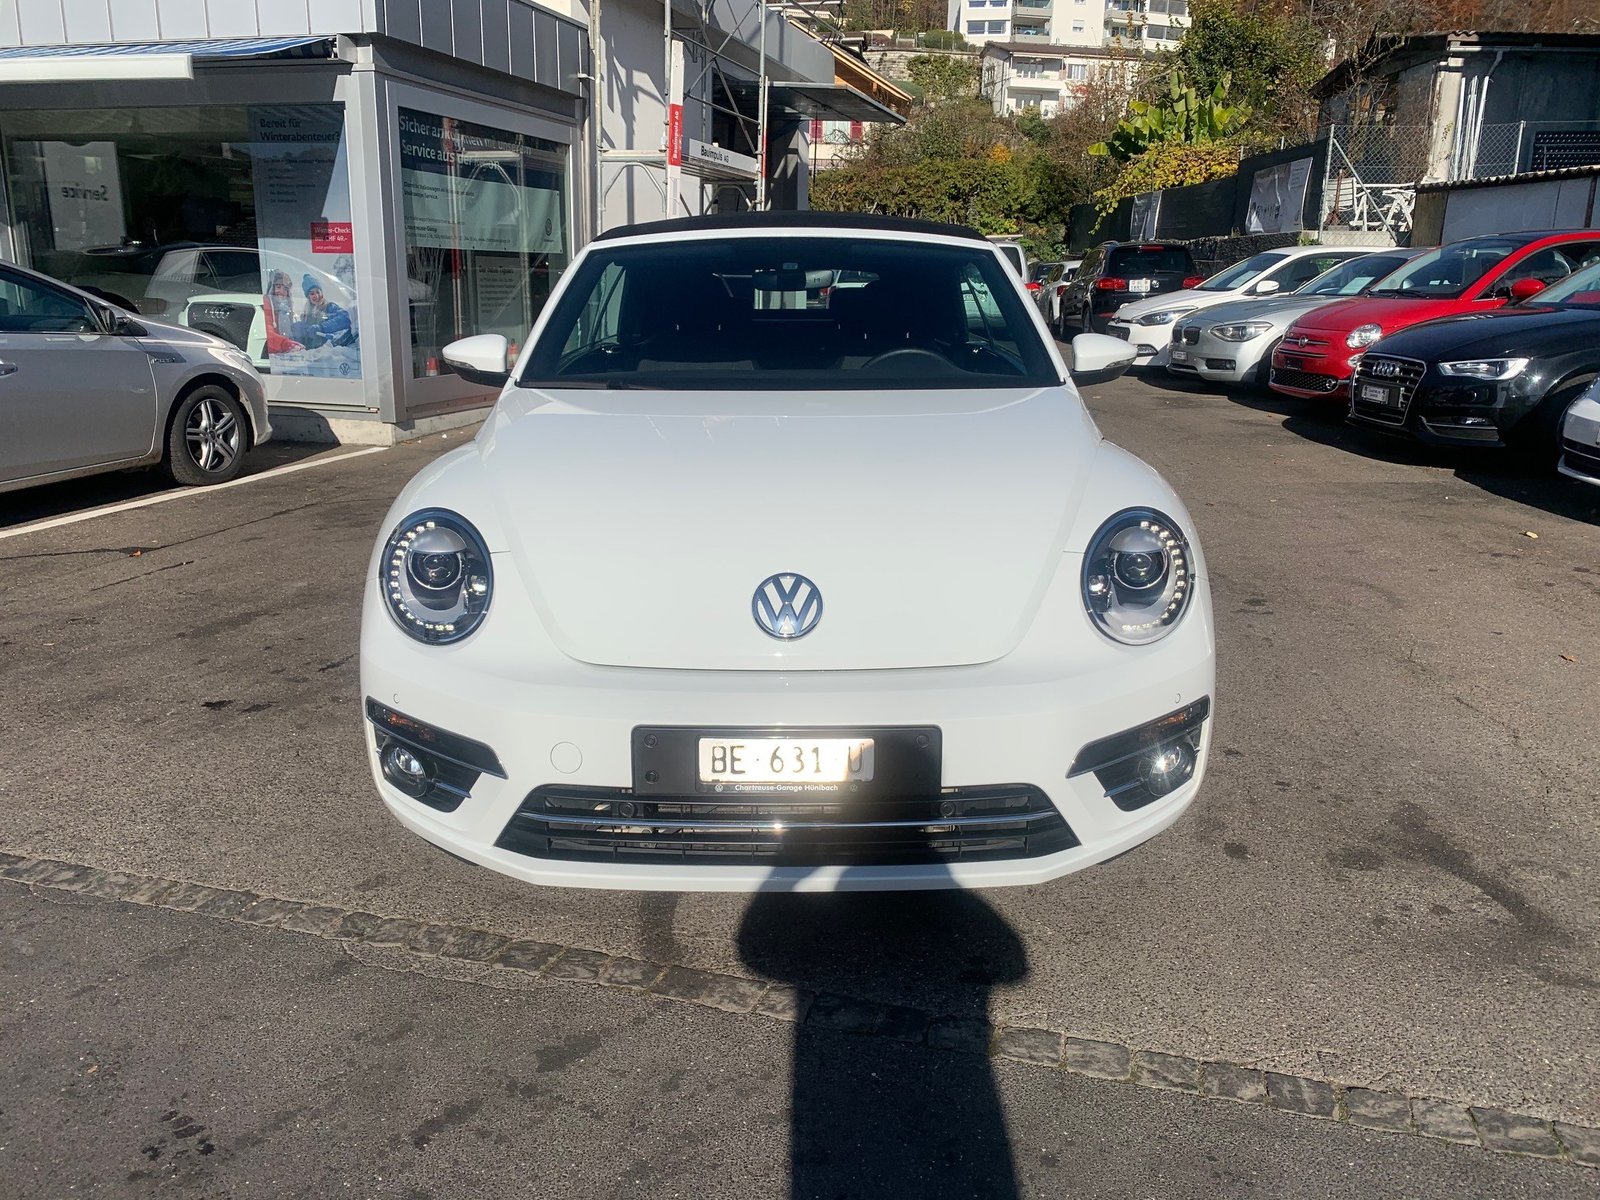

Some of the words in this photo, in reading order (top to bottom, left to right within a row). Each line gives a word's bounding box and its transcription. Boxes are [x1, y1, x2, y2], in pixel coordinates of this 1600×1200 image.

[260, 118, 287, 129] Bereit
[289, 118, 301, 128] für
[399, 115, 430, 135] Sicher
[260, 131, 340, 141] Winterabenteuer?
[402, 140, 436, 160] Service
[437, 149, 456, 163] aus
[701, 145, 723, 161] Bauimpuls
[724, 155, 730, 163] AG
[711, 745, 746, 774] BE
[770, 745, 822, 773] 631
[847, 743, 864, 773] U
[734, 784, 803, 792] Chartreuse-Garage
[804, 784, 839, 792] Hünibach
